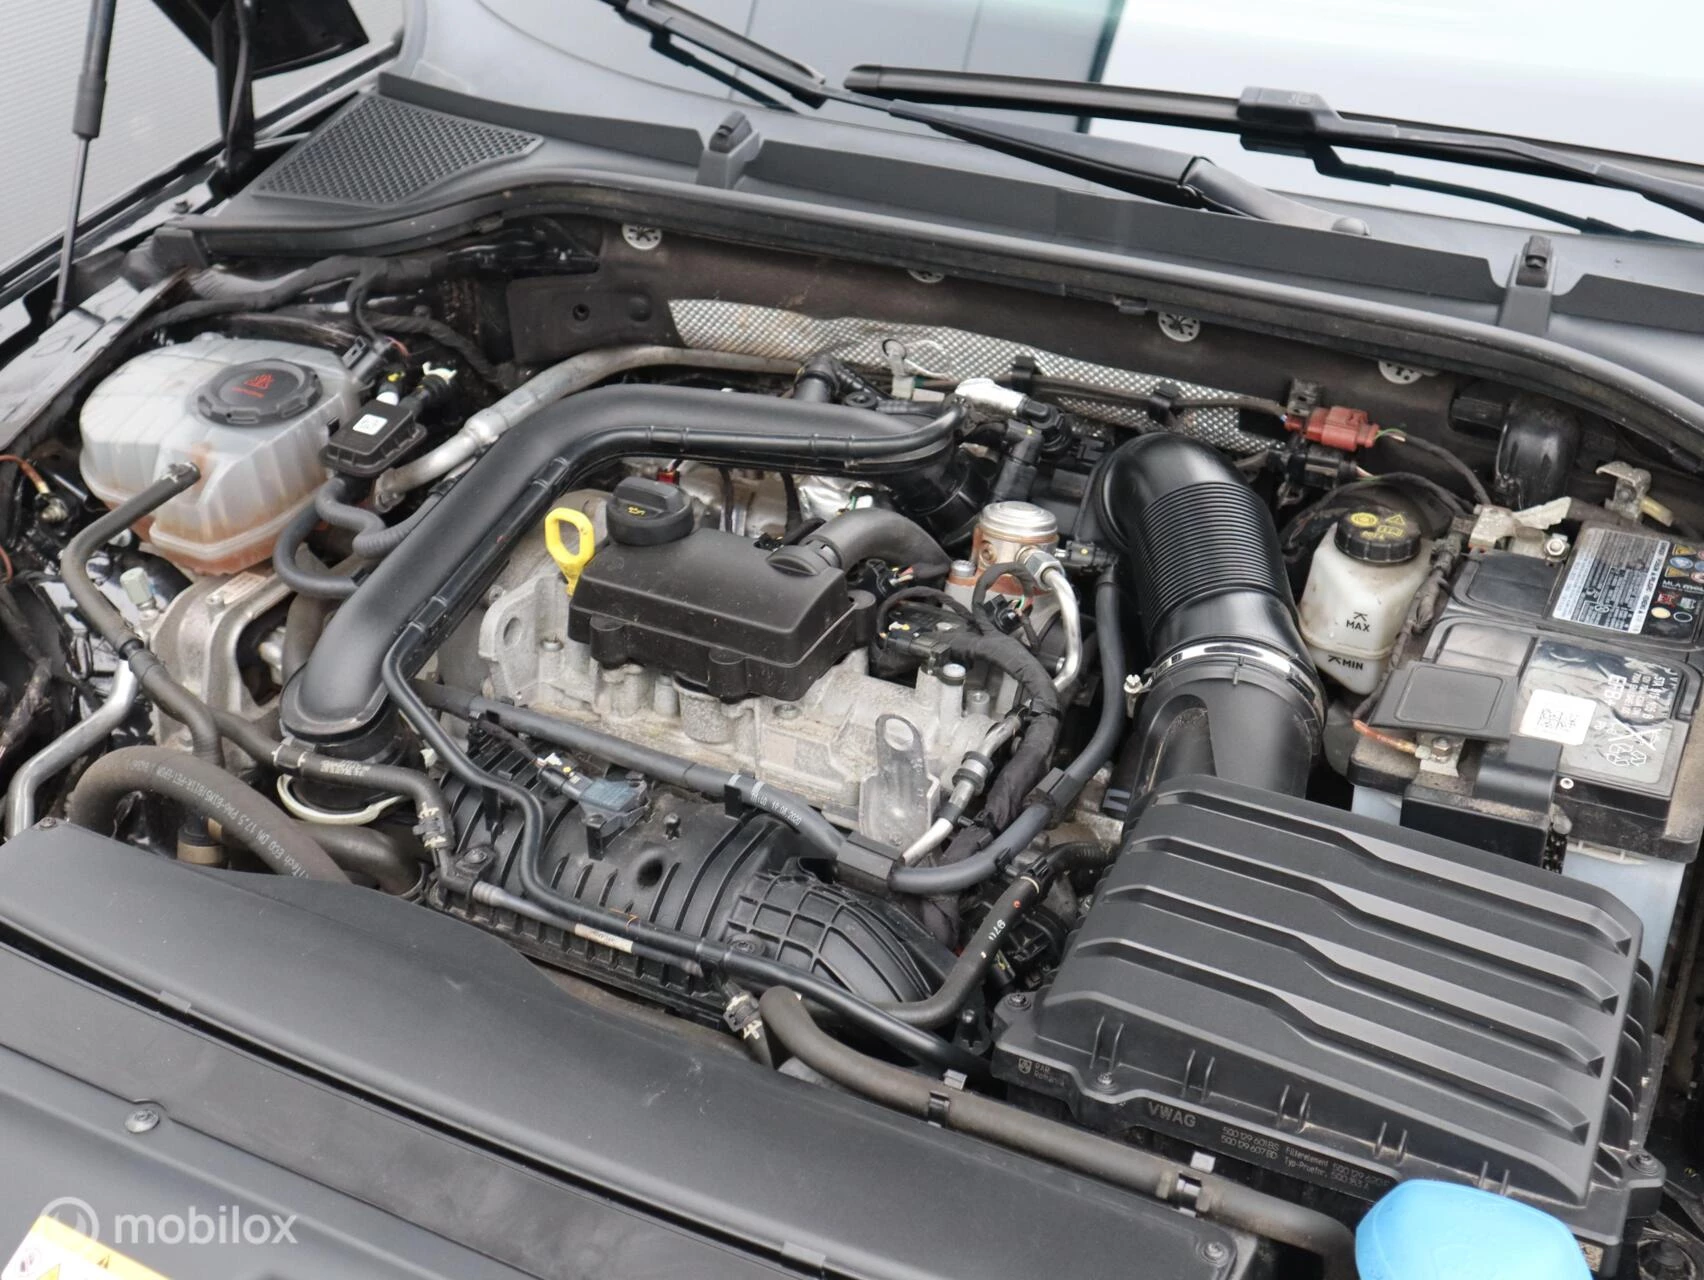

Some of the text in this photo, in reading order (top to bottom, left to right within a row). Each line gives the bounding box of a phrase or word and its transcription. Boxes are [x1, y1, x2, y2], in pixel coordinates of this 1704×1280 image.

[1346, 620, 1370, 632] MAX
[1342, 660, 1364, 671] MIN
[1148, 1102, 1197, 1128] VWAG
